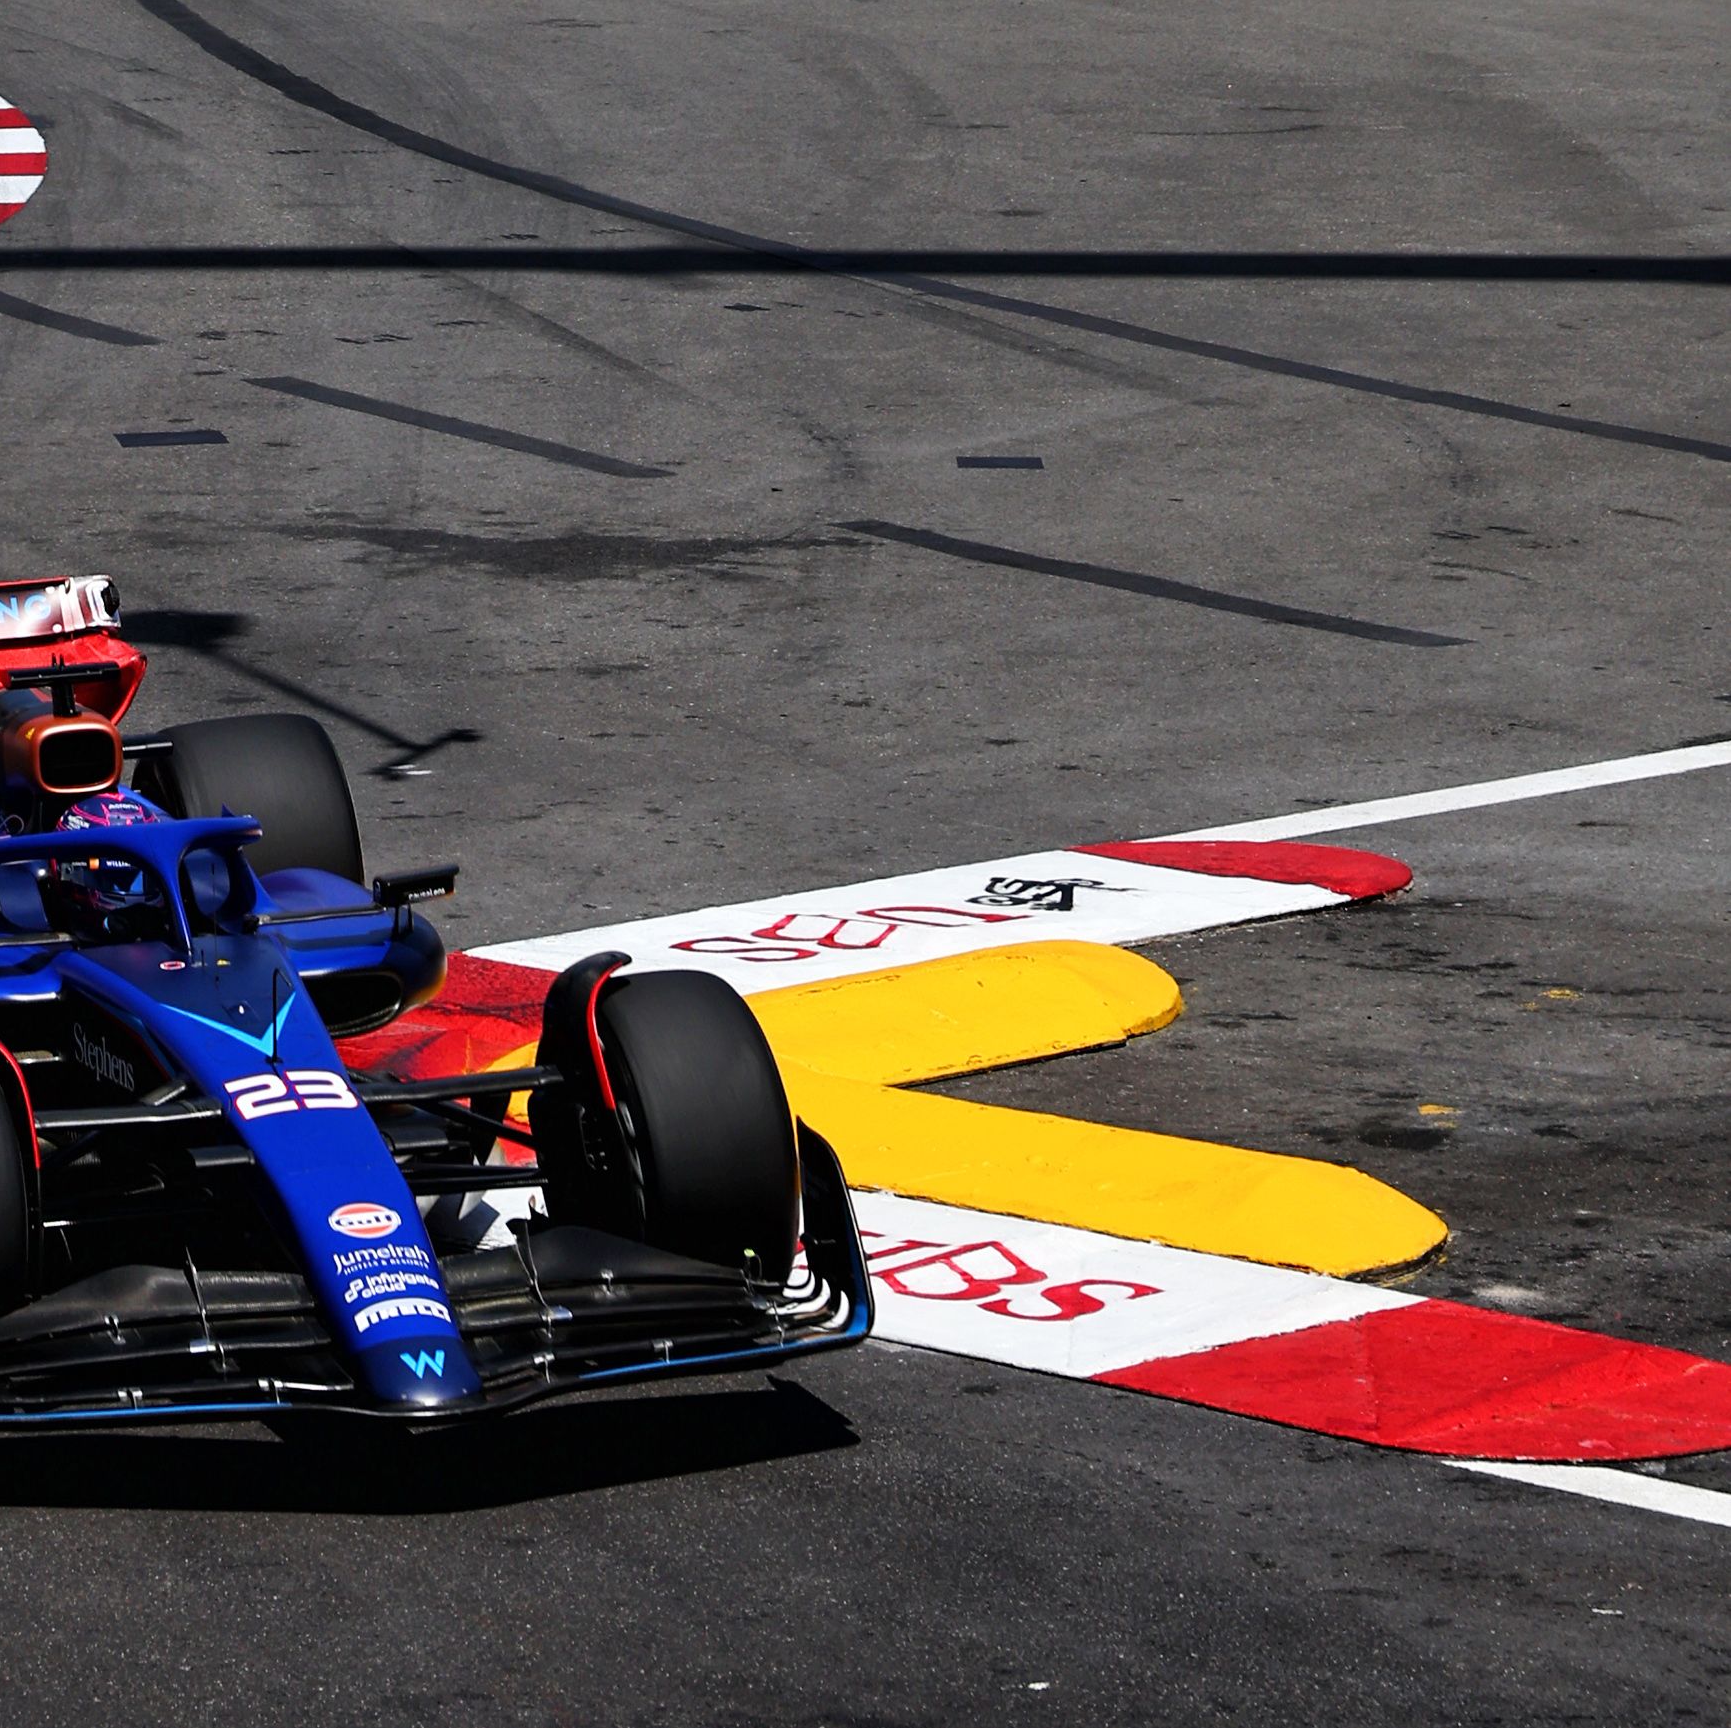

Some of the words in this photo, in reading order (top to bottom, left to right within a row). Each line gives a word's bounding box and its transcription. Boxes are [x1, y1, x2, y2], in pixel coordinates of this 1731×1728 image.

[73, 1022, 136, 1093] Stephens
[223, 1069, 360, 1121] 23
[332, 1242, 430, 1276] Jumeirah
[353, 1297, 452, 1334] PIRELLI
